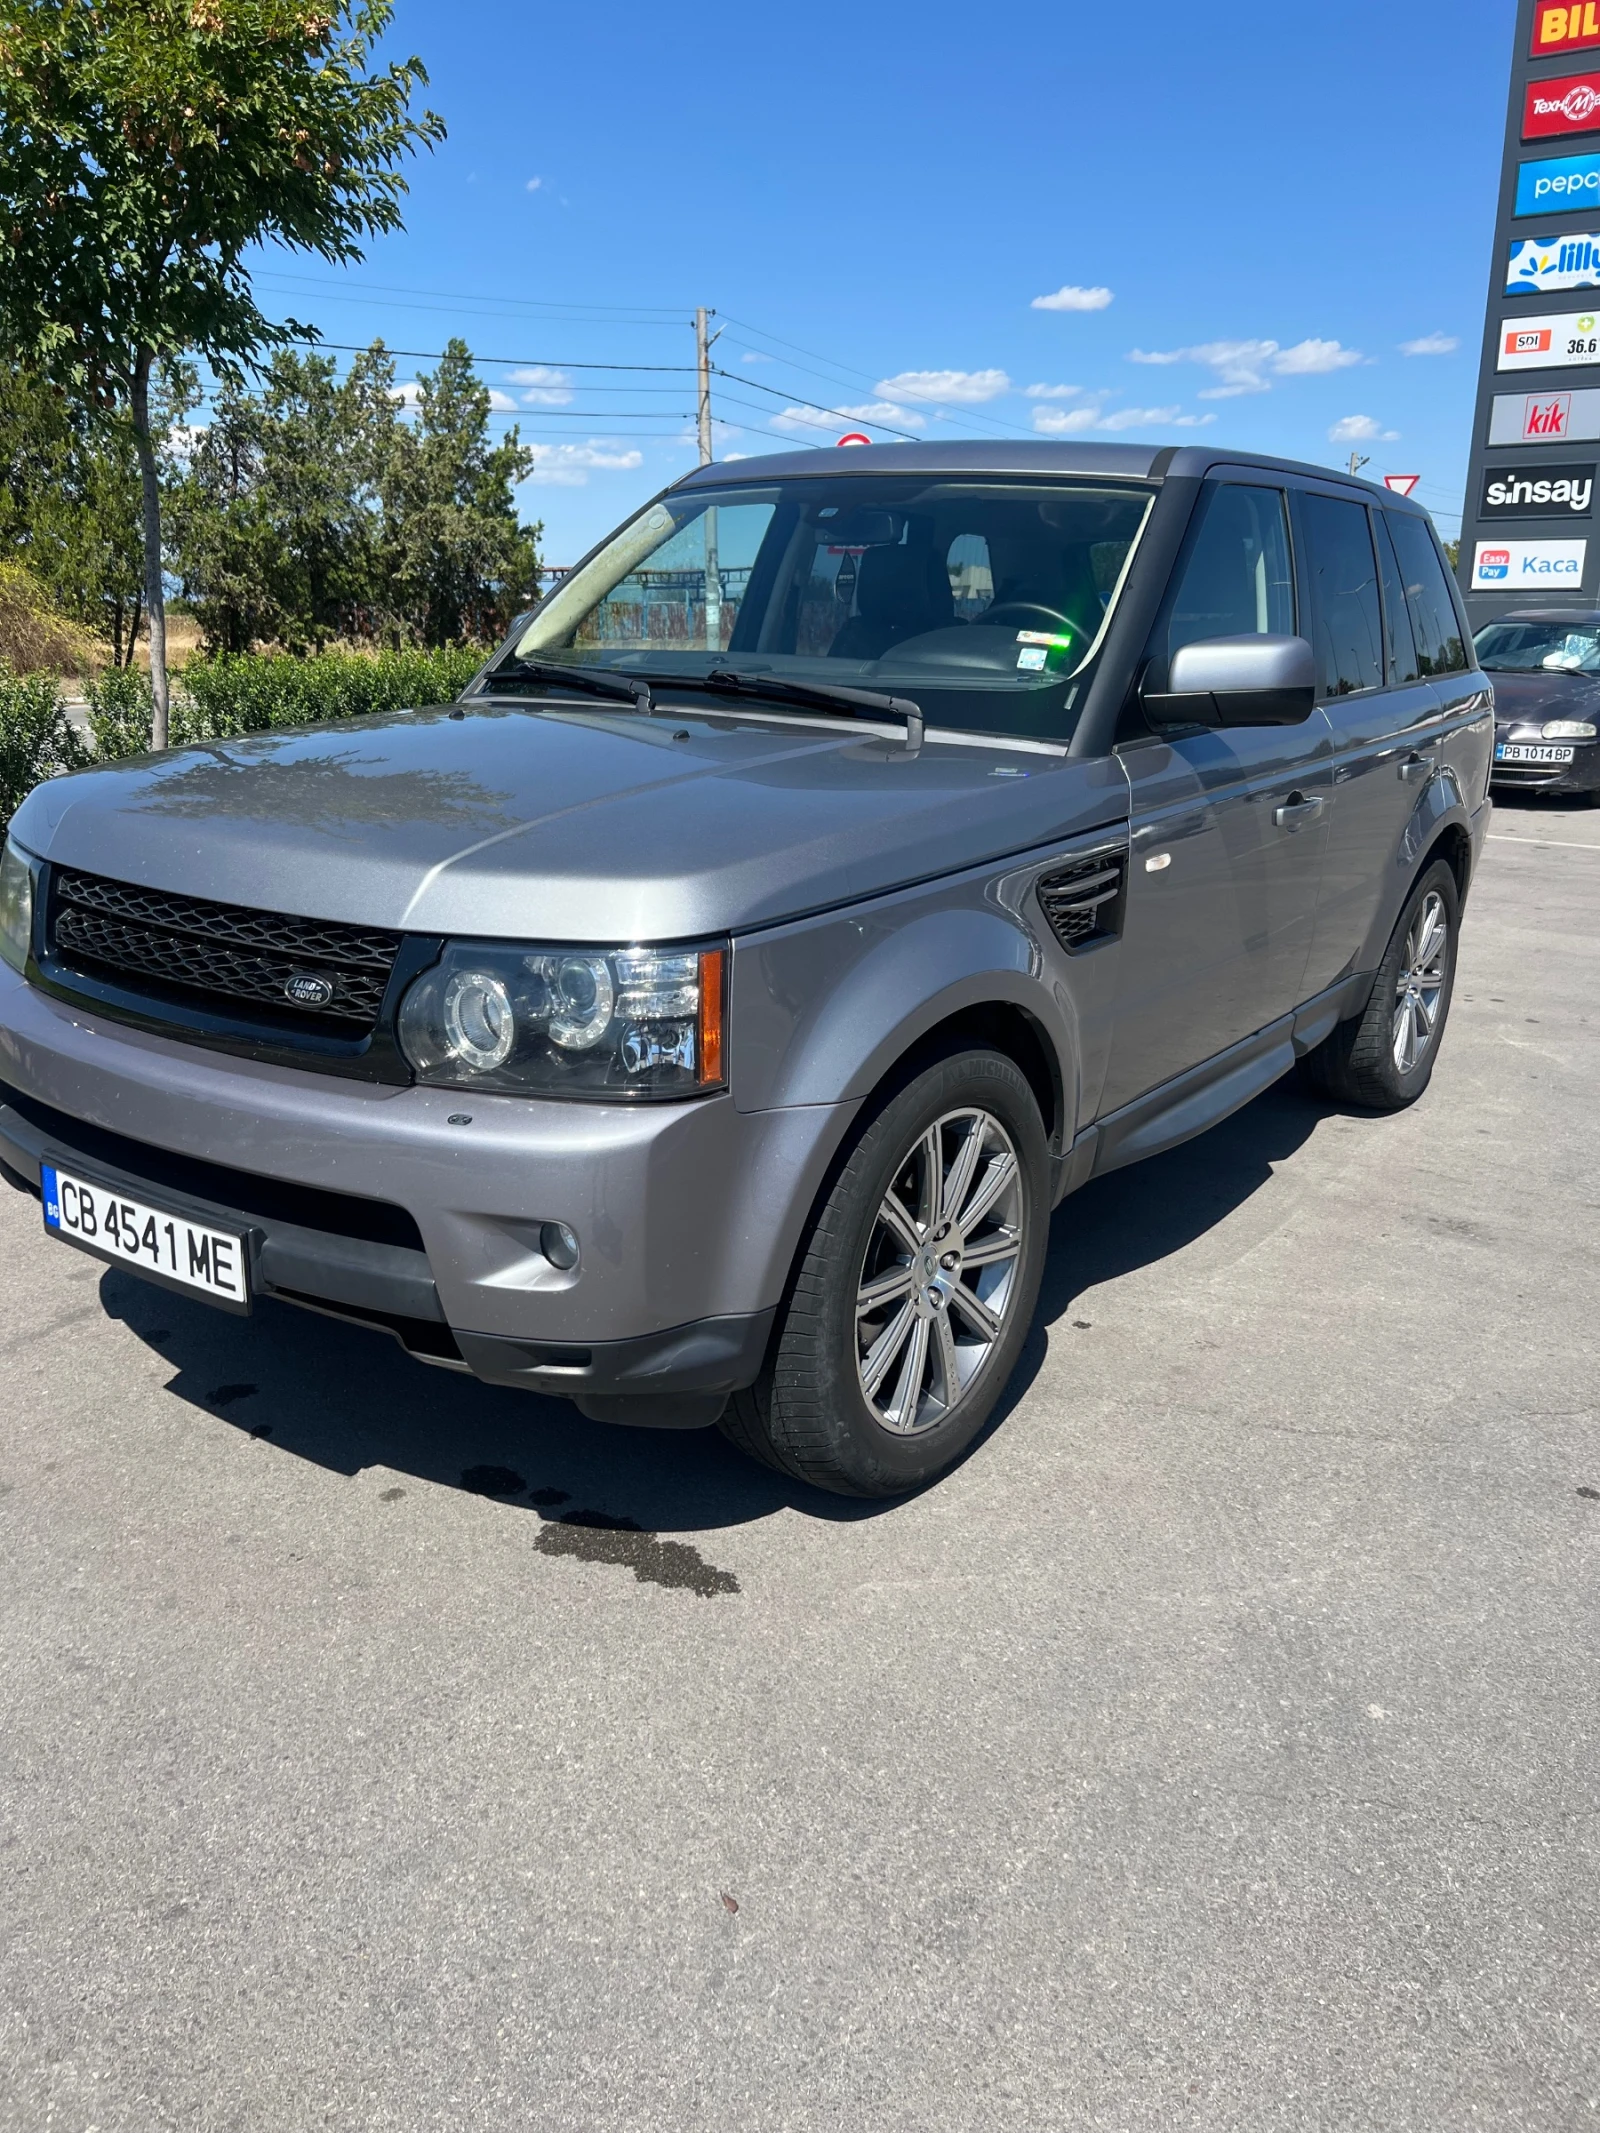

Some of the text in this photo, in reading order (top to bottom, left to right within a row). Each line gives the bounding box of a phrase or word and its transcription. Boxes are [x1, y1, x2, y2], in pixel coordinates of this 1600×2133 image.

[1535, 172, 1600, 199] pepc
[1518, 335, 1538, 347] SDI
[1567, 338, 1597, 354] 36.6
[1527, 403, 1565, 434] kik
[1486, 475, 1592, 511] sinsay
[1483, 553, 1507, 565] Easy
[1481, 567, 1500, 577] Pay
[1504, 746, 1520, 758] PB
[1524, 747, 1553, 760] 1014
[1555, 748, 1571, 760] BP
[294, 979, 316, 991] LAND
[294, 989, 322, 1001] ROVER
[47, 1201, 60, 1219] BG
[61, 1180, 237, 1292] CB 4541 ME
